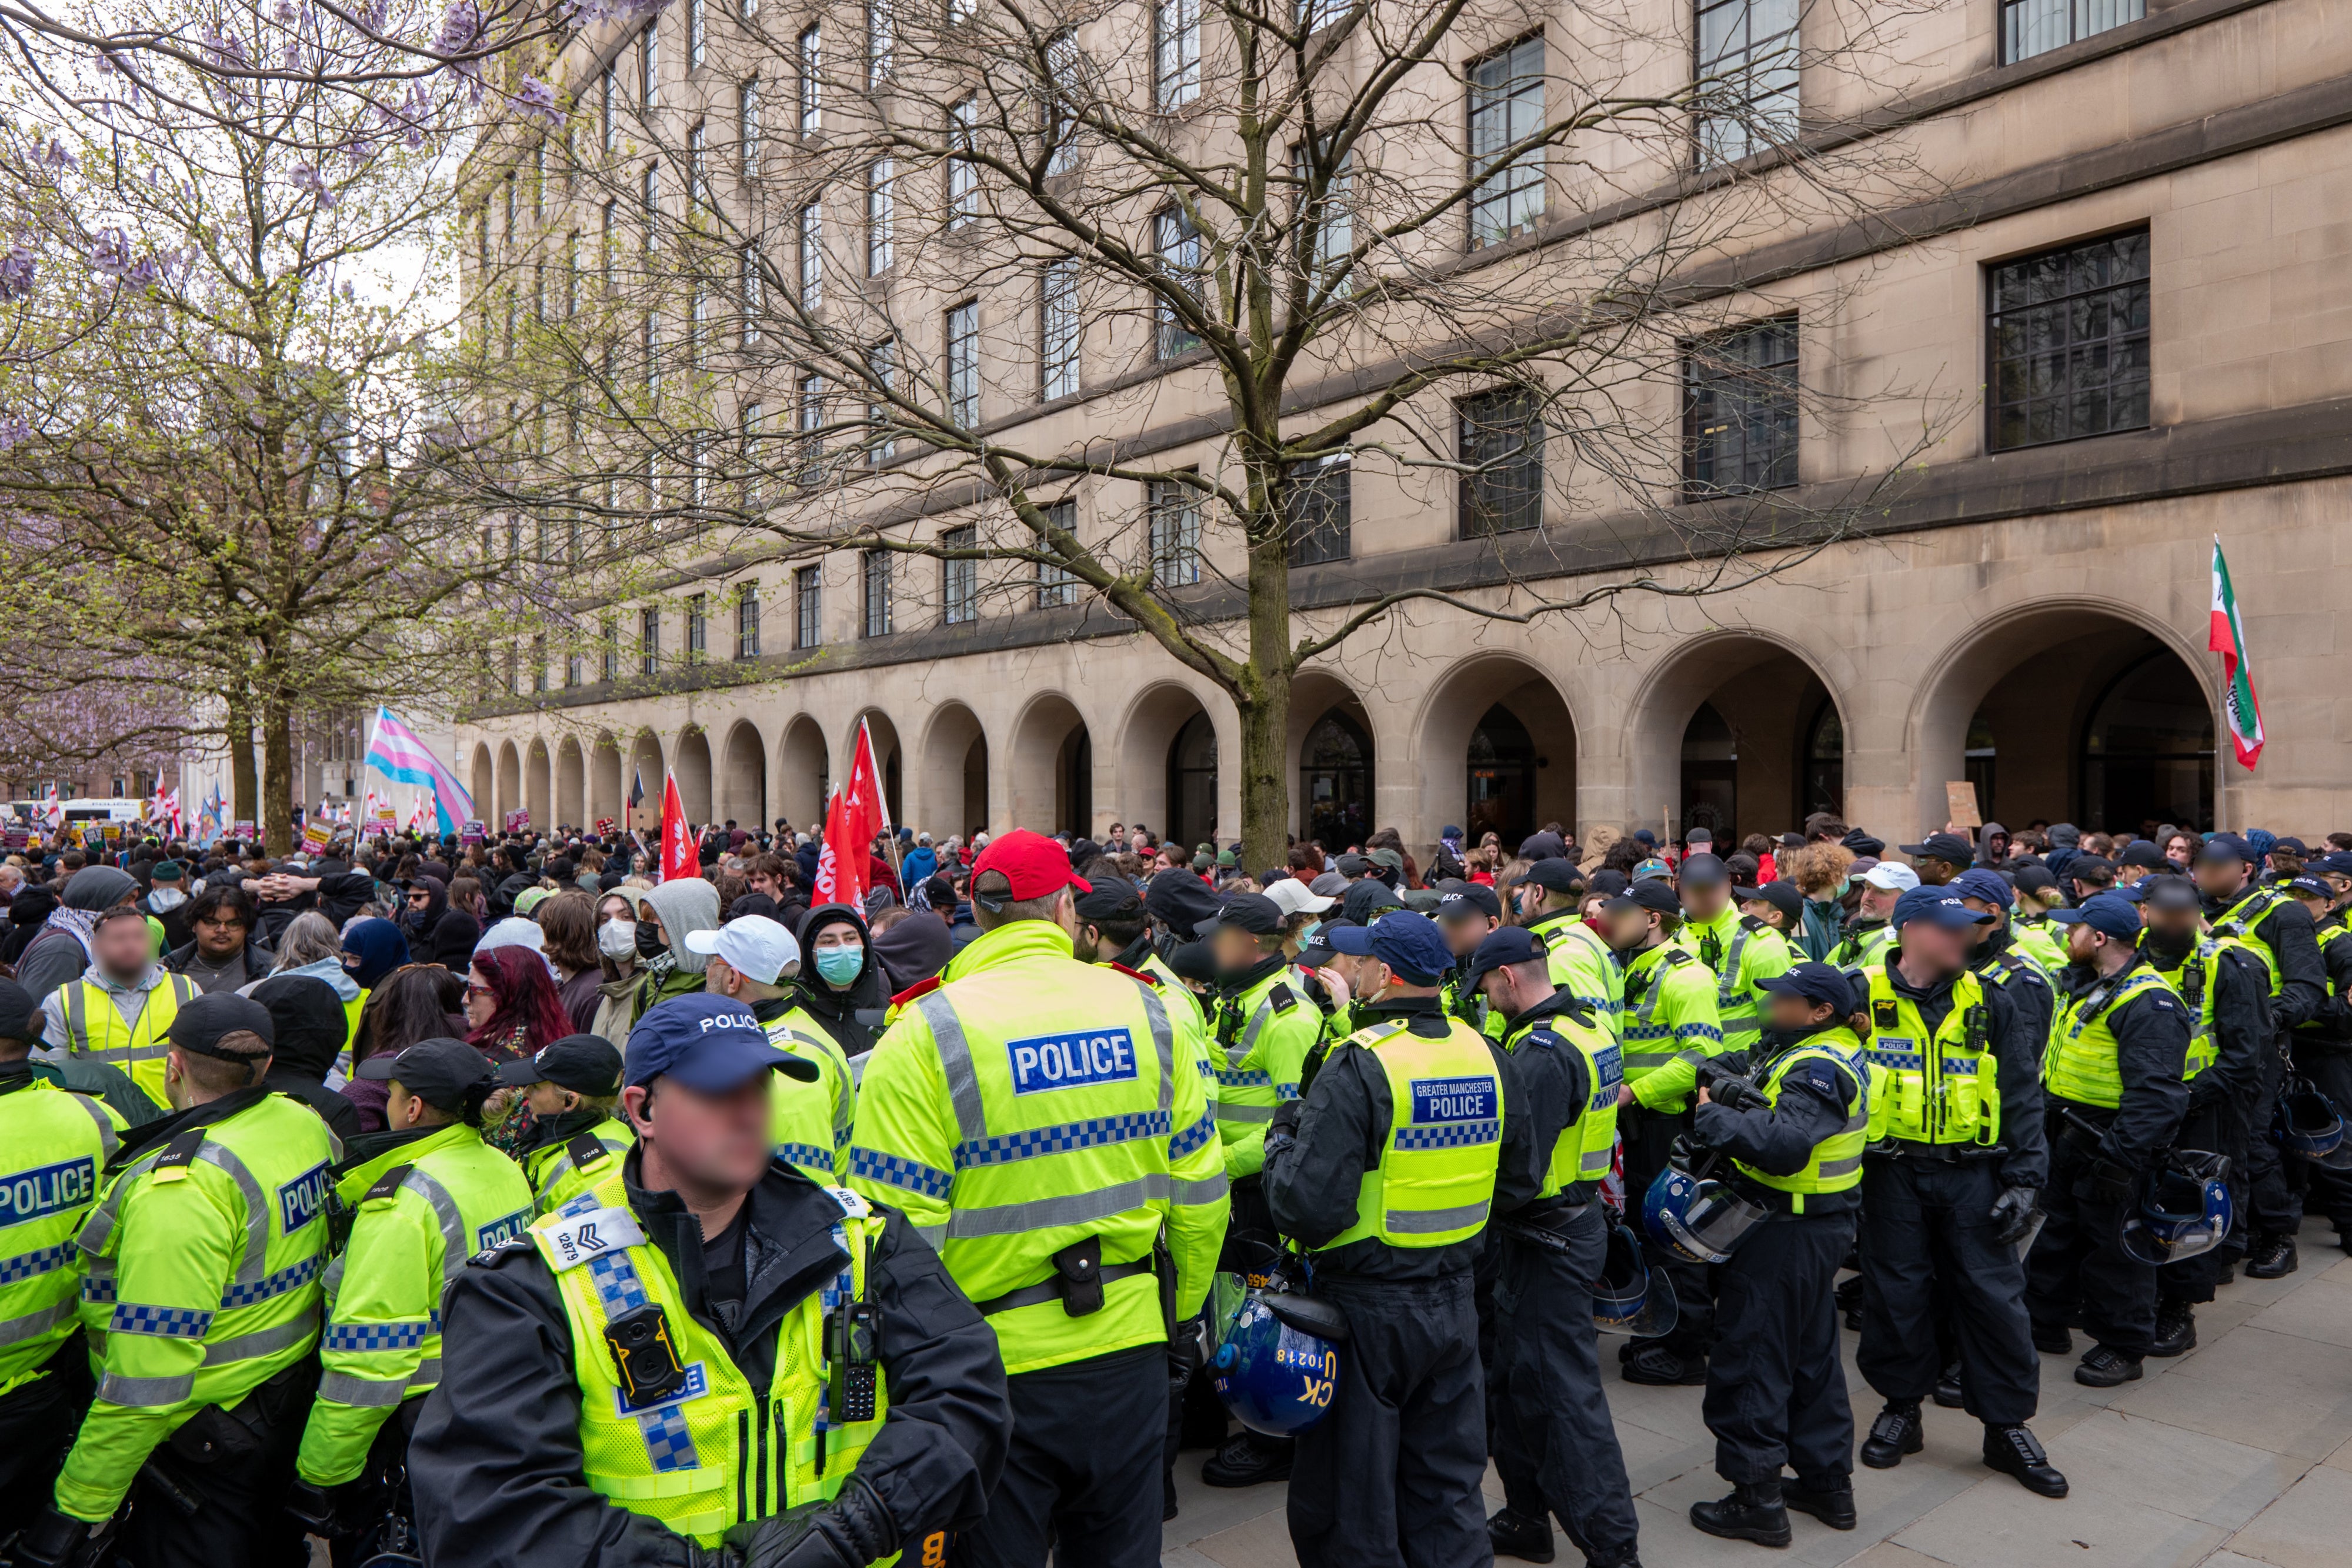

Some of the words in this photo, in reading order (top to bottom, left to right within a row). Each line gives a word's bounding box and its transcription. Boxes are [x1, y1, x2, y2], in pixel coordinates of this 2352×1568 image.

[1014, 1036, 1132, 1084] POLICE
[1416, 1084, 1449, 1097] GREATER
[1449, 1081, 1493, 1095] MANCHESTER
[1811, 1079, 1829, 1090] 16274
[1430, 1095, 1484, 1118] POLICE
[160, 1153, 182, 1162] 1635
[581, 1148, 599, 1159] 7249
[837, 1191, 857, 1207] 12879
[557, 1232, 579, 1262] 12879
[1247, 1273, 1269, 1287] 455
[1275, 1349, 1323, 1371] 10218
[654, 1389, 667, 1397] AXON
[1295, 1374, 1334, 1406] CK
